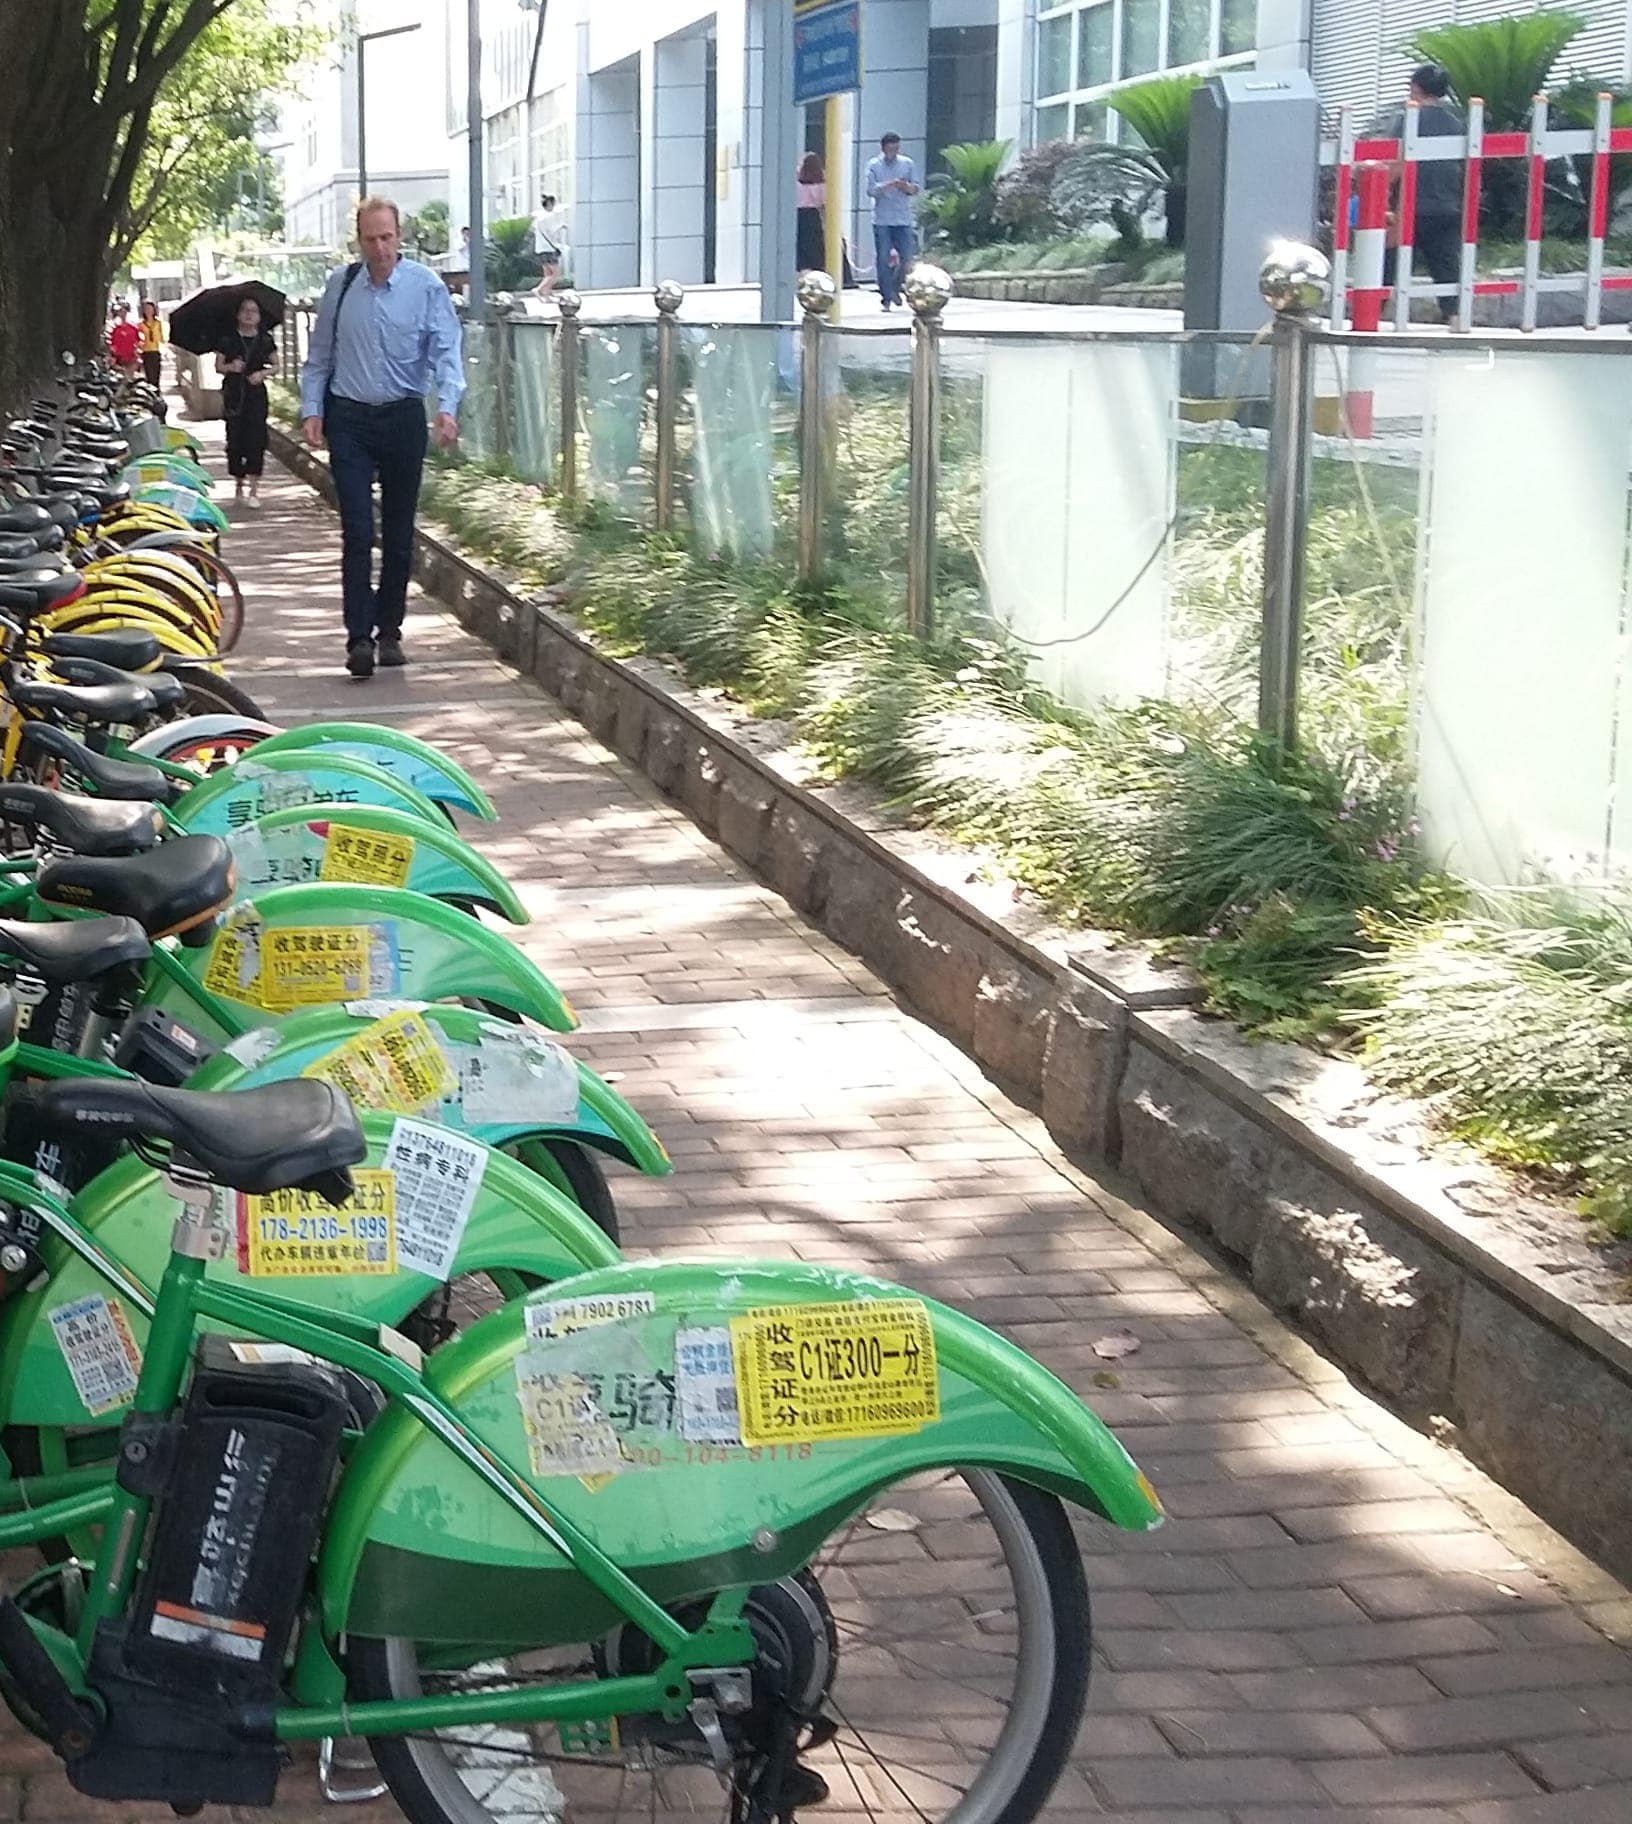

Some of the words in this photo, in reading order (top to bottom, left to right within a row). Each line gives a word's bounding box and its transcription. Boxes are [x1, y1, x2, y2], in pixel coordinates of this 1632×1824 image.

[260, 1216, 387, 1240] 178-2136-1998
[767, 1322, 799, 1427] 收驾证分
